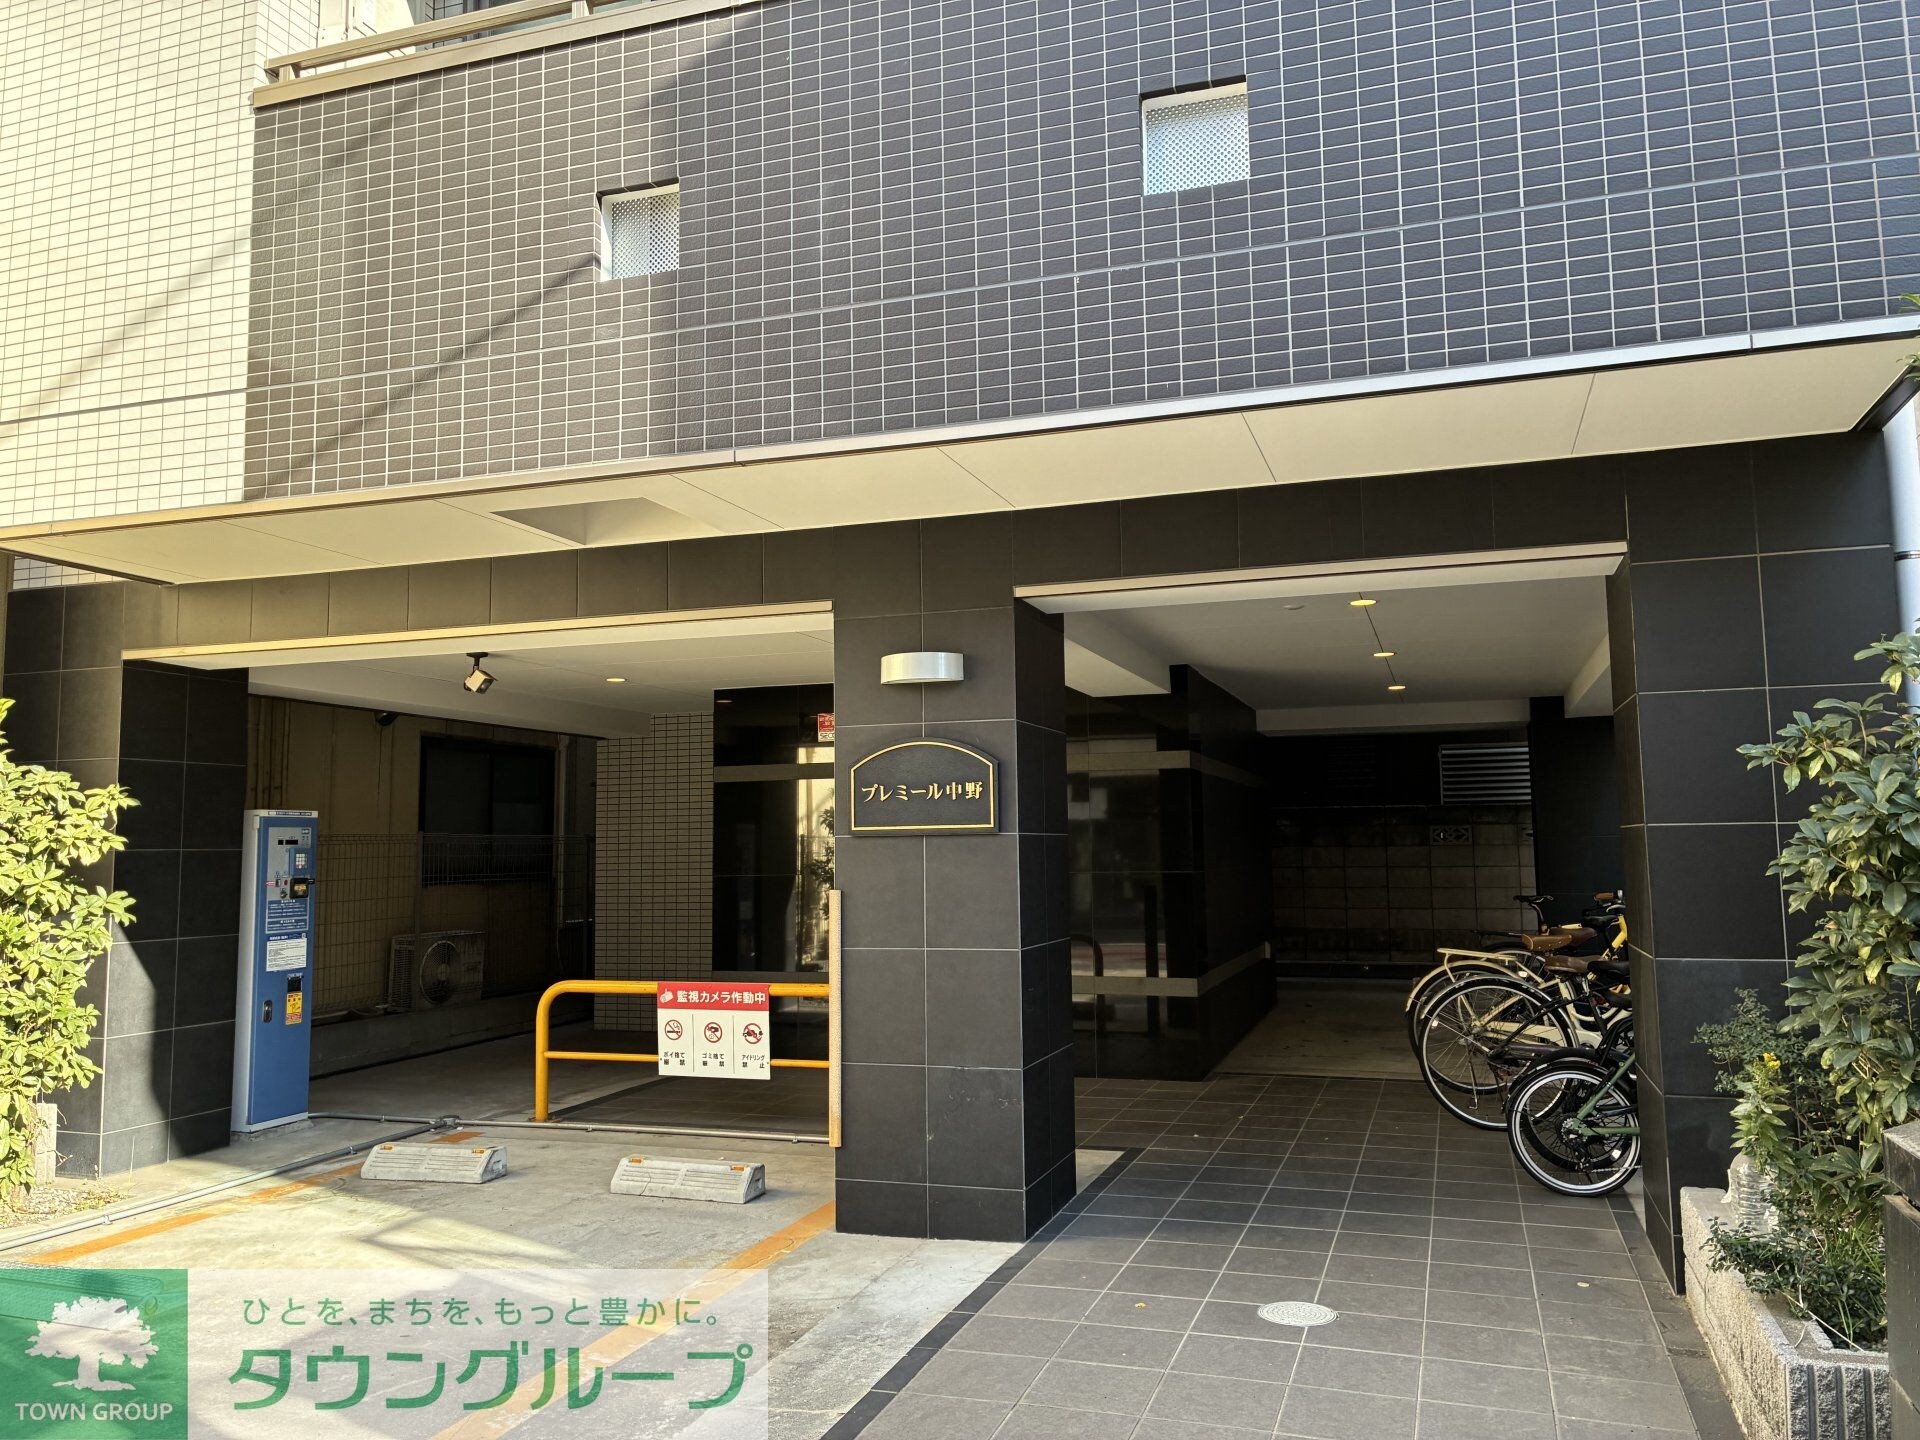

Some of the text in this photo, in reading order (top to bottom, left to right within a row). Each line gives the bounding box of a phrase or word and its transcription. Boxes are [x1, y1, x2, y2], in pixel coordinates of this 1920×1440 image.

[861, 781, 982, 803] プレミール中野
[677, 990, 766, 1005] 監視カメラ作動中
[663, 1051, 686, 1059] ポイ捨て
[702, 1052, 725, 1060] ゴミ捨て
